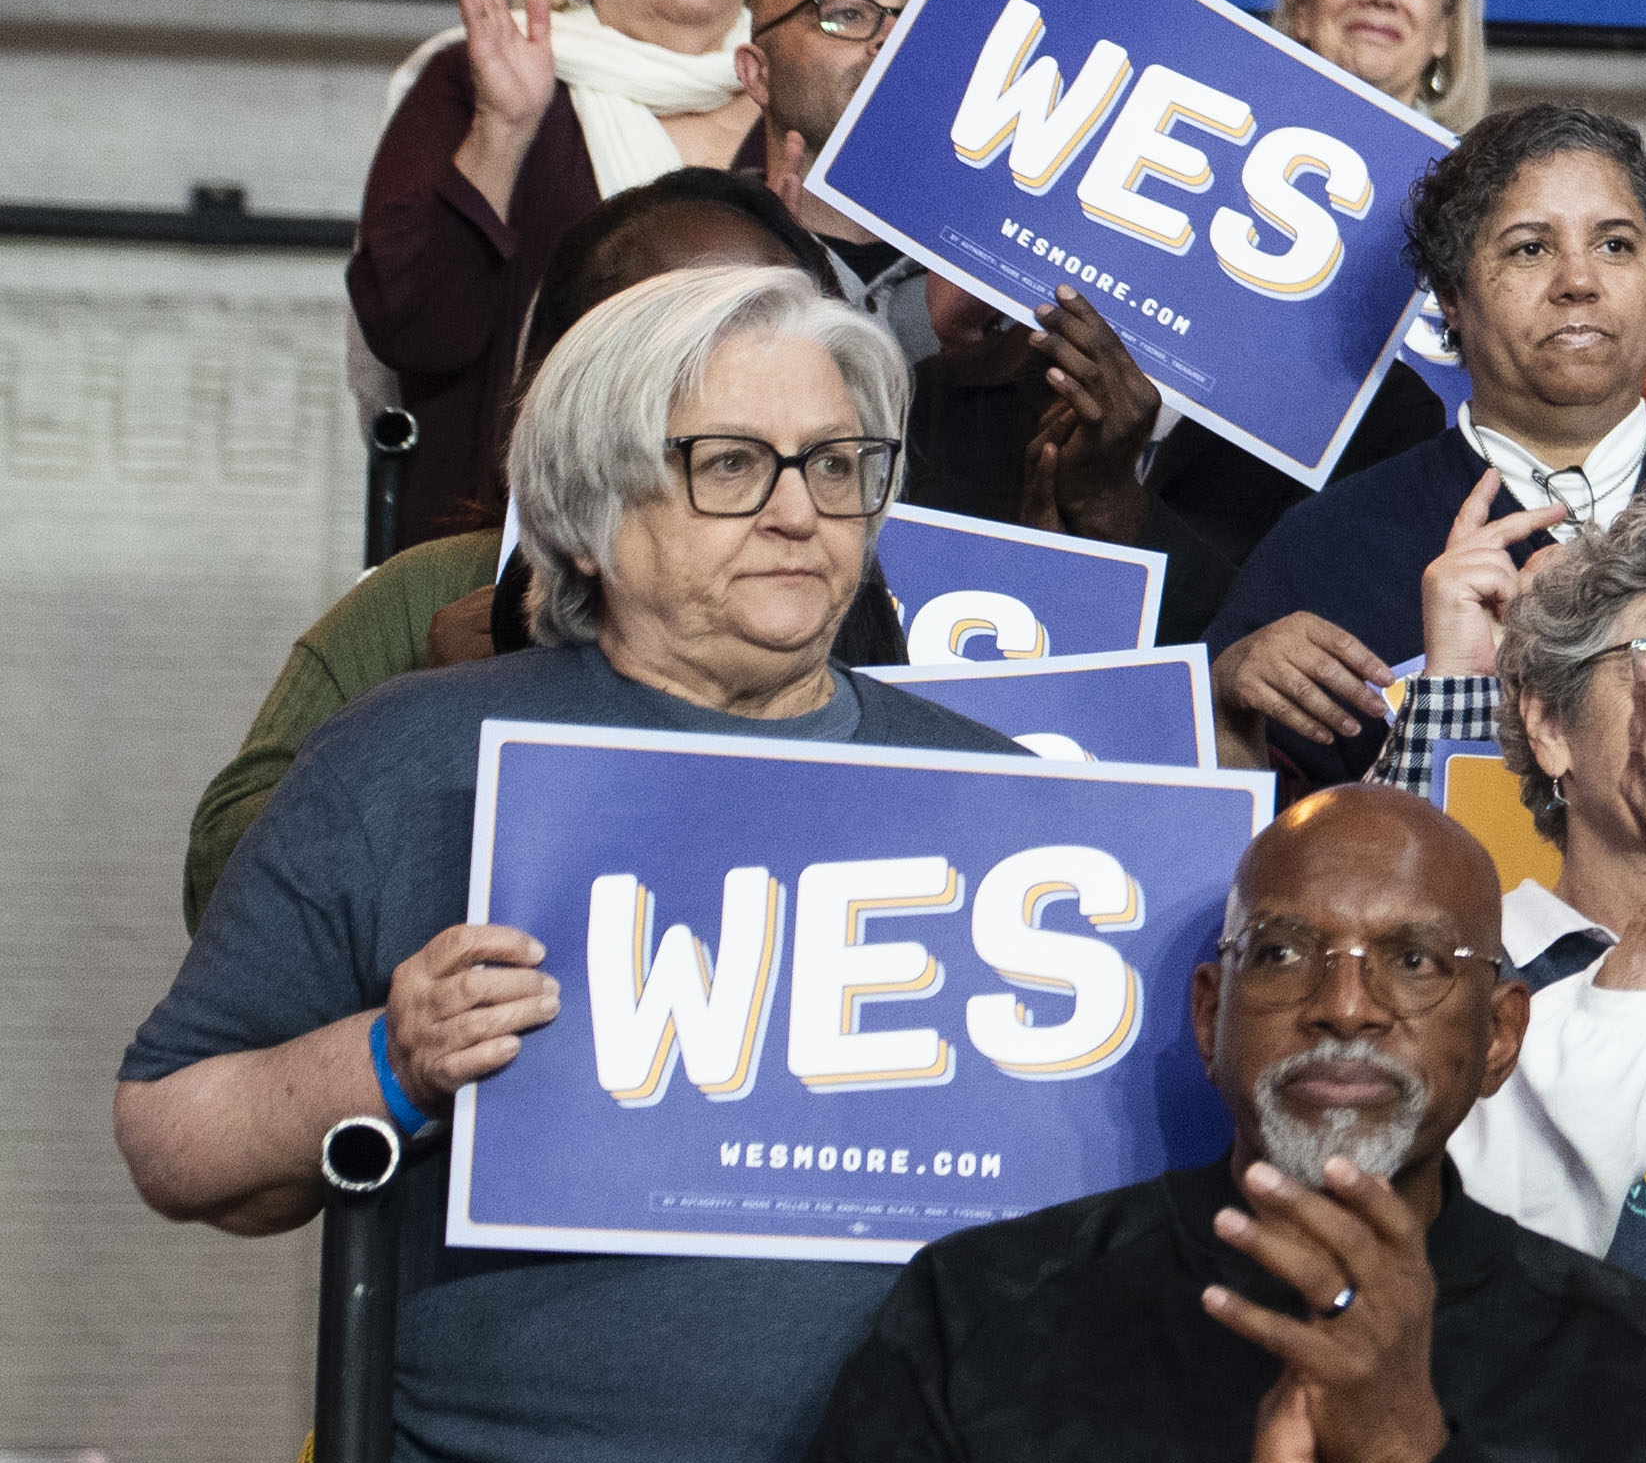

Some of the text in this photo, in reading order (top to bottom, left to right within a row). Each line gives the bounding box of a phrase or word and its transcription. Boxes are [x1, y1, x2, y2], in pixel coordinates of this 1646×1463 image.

[1000, 217, 1192, 337] WESMOORE.COM
[587, 844, 1145, 1109] WES
[719, 1141, 1002, 1178] WESMOORE.COM
